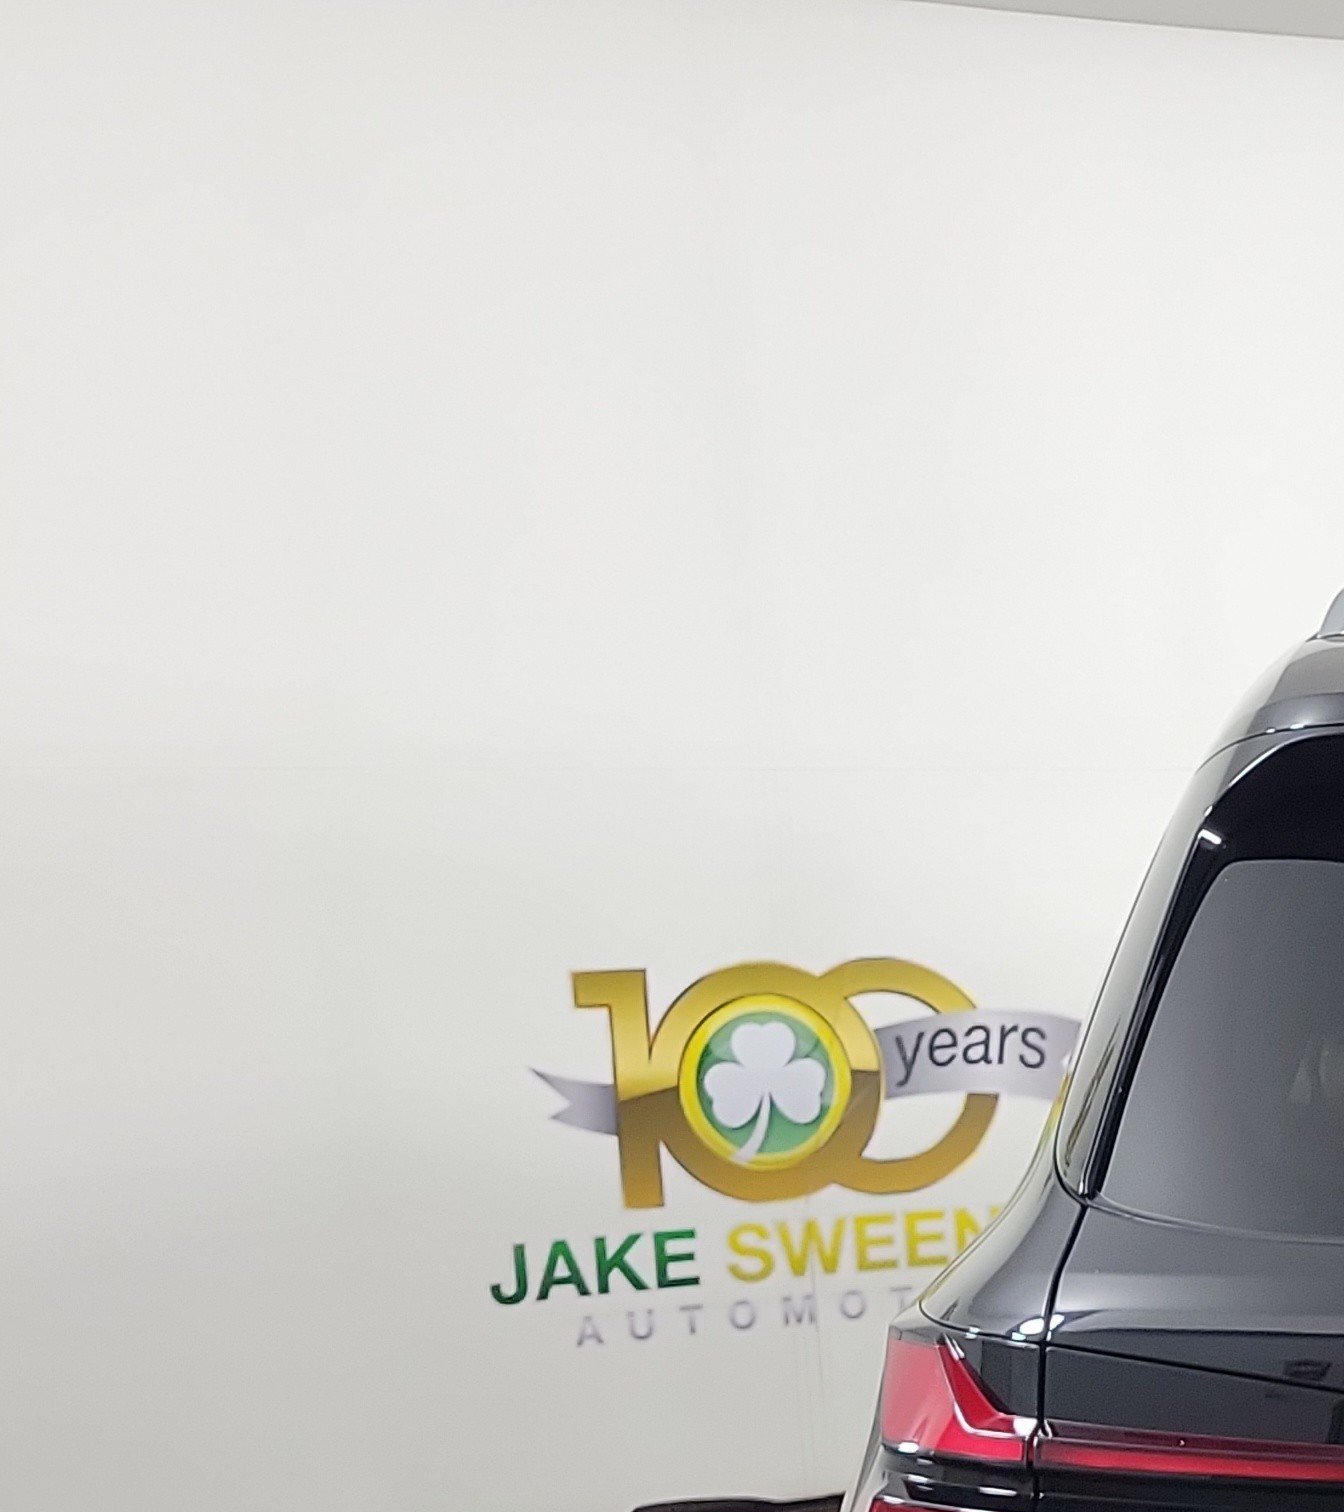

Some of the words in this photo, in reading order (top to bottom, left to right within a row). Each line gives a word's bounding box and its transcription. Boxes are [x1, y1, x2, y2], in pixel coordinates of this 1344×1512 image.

[570, 957, 999, 1209] 100
[894, 1021, 1047, 1085] years
[490, 1228, 701, 1305] JAKE
